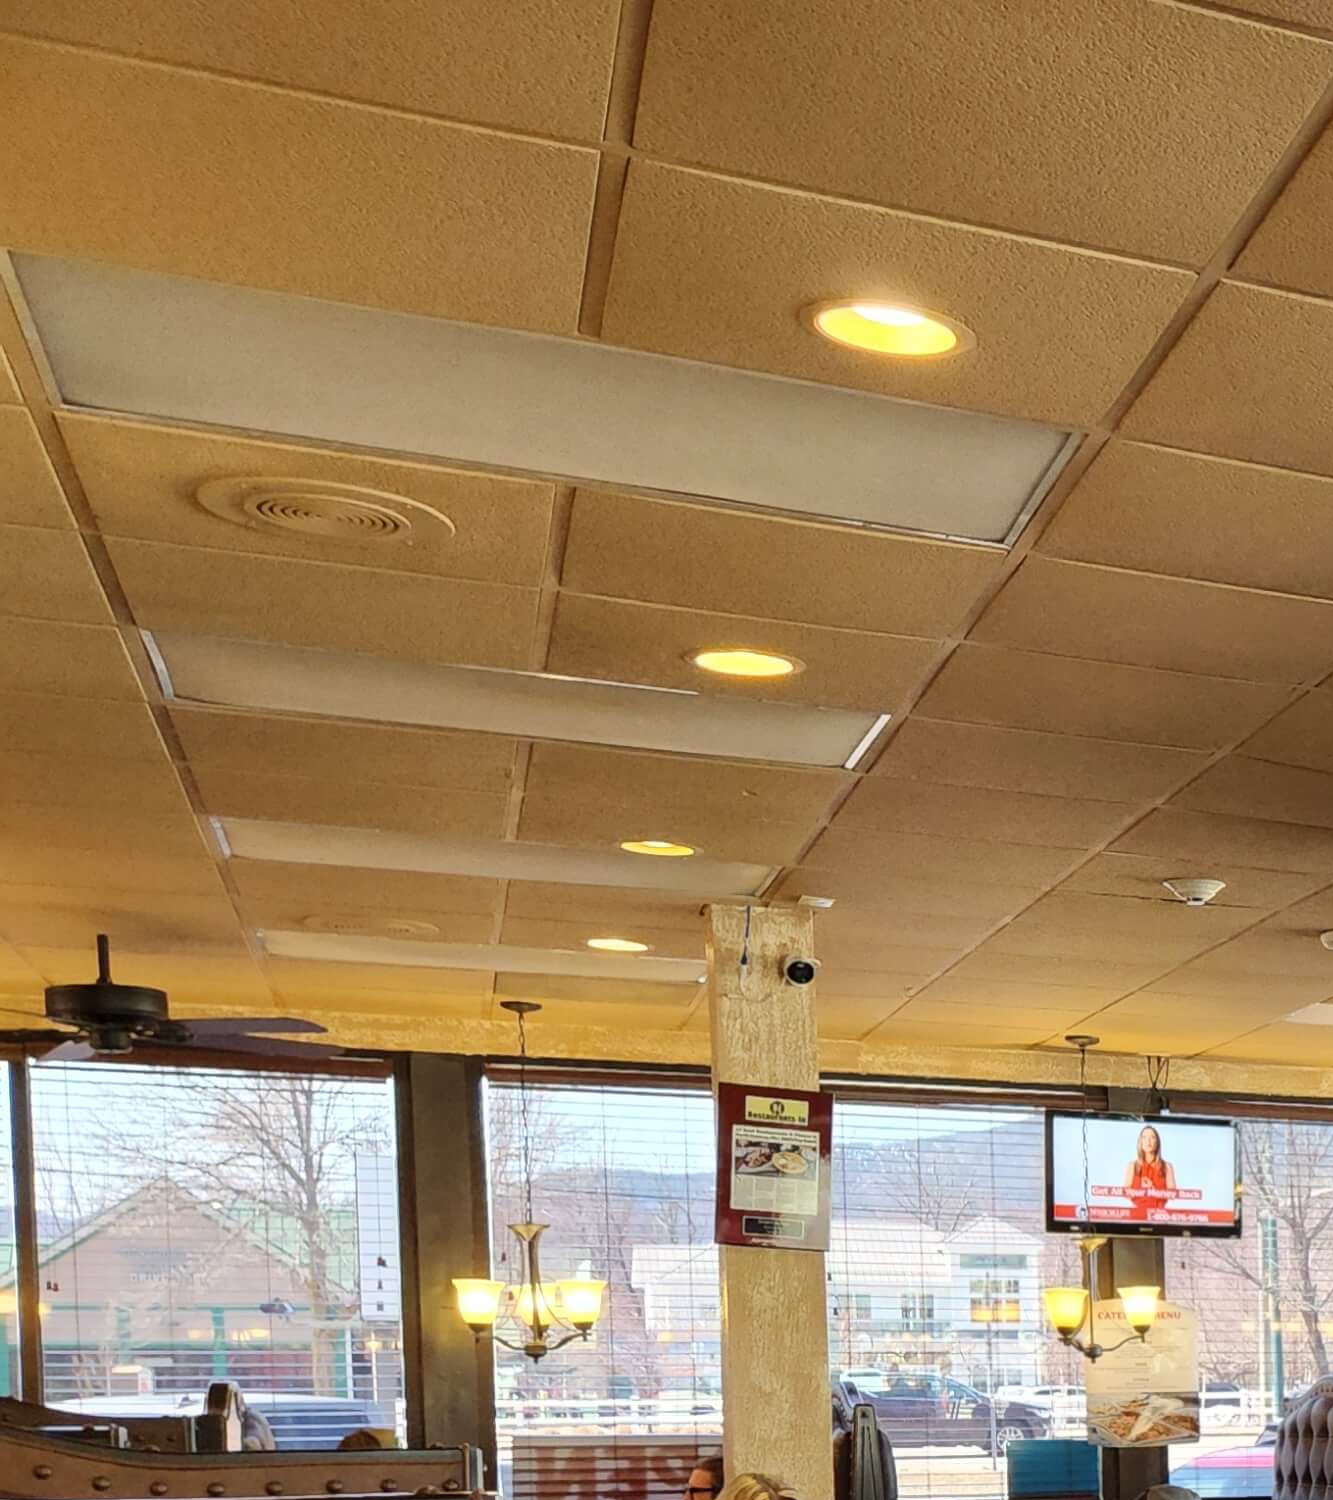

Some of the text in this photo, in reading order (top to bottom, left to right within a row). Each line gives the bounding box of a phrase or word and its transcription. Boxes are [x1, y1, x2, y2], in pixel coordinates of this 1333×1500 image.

[1092, 1187, 1109, 1195] Get
[1111, 1187, 1123, 1196] All
[1125, 1188, 1146, 1197] Your
